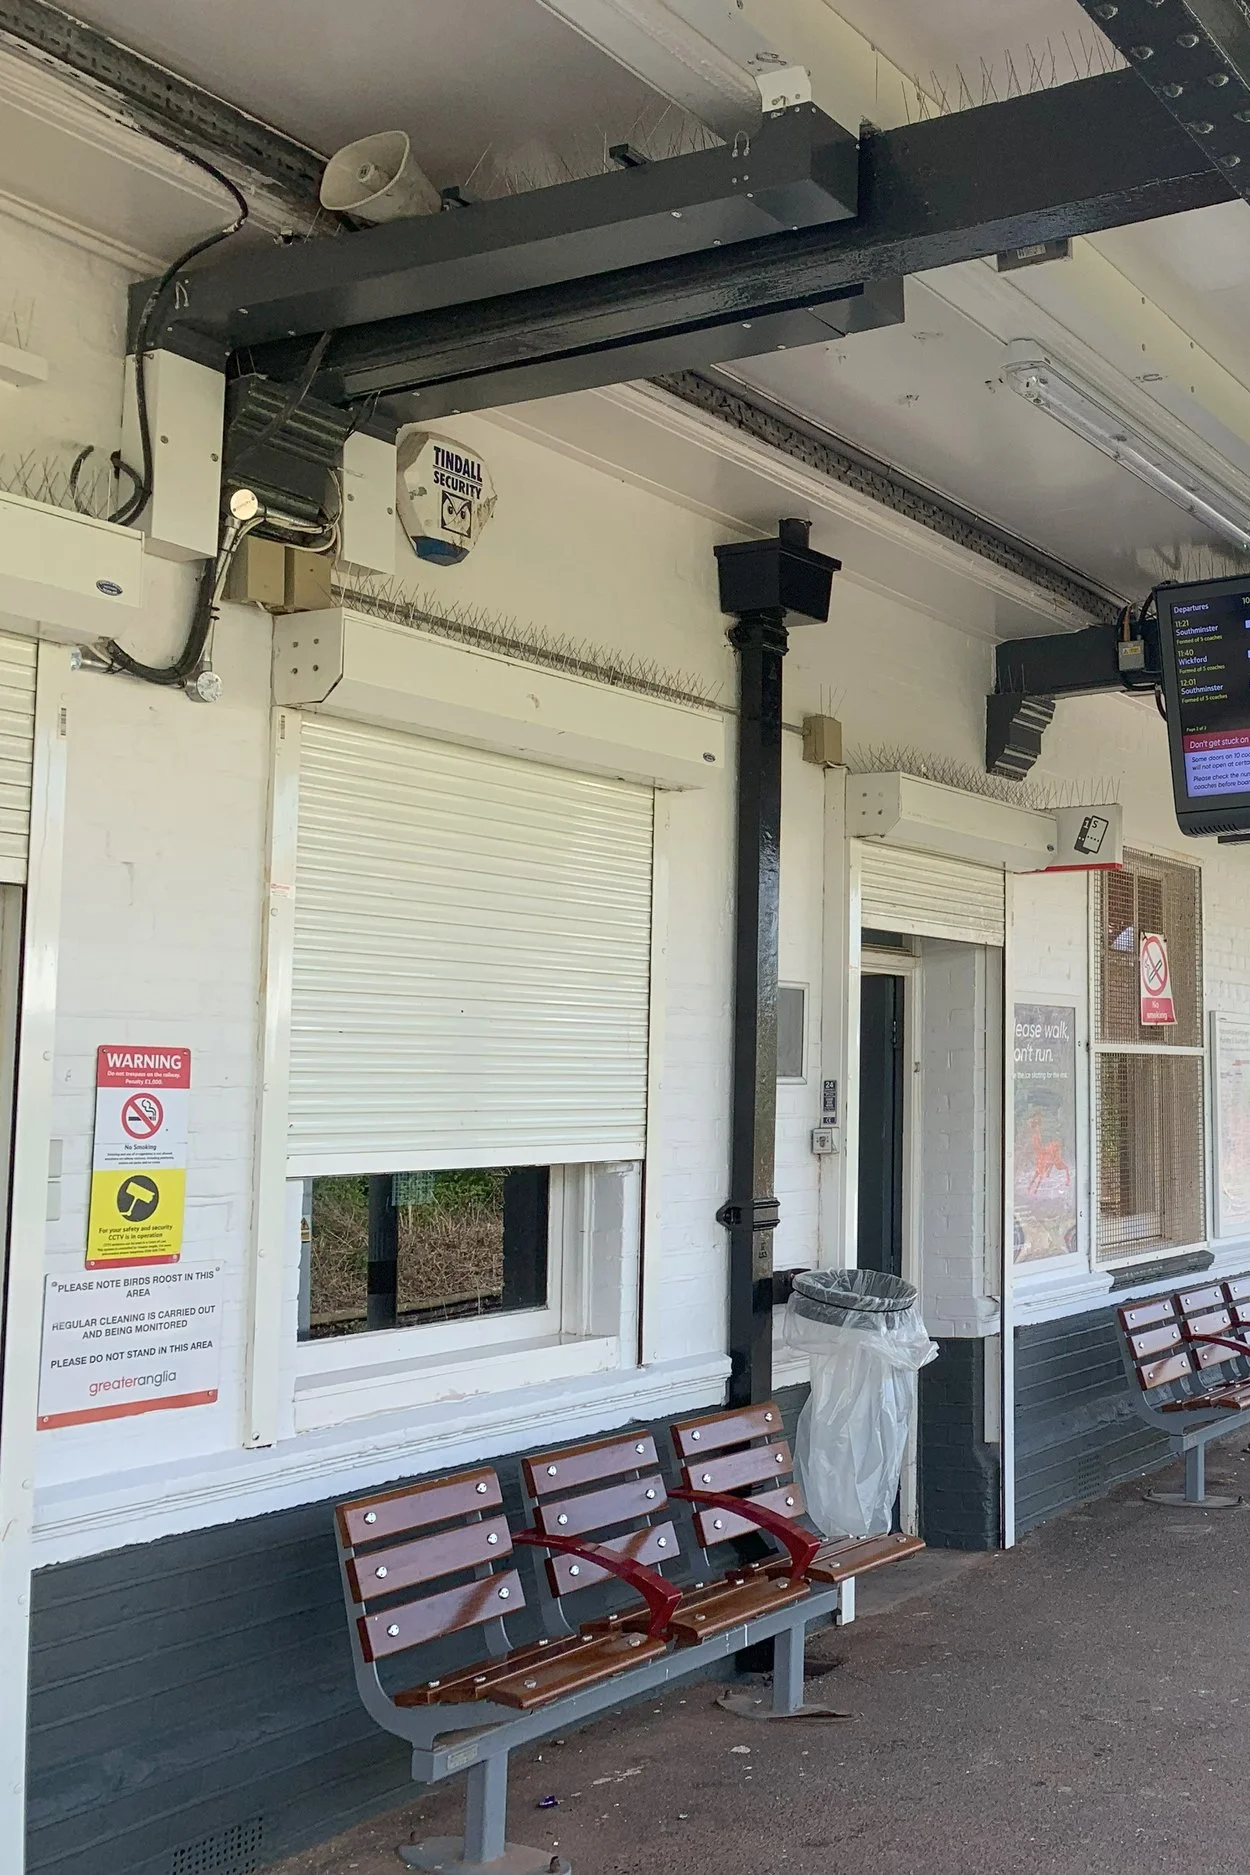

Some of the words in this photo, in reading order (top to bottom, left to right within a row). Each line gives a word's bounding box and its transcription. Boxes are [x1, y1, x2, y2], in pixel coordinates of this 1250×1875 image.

[433, 446, 483, 483] TINDALL
[433, 470, 481, 500] SECURITY
[1174, 604, 1209, 614] Departures
[1175, 620, 1189, 628] 11:21
[1176, 625, 1218, 636] Southminster
[1178, 649, 1194, 657] 11:40
[1178, 656, 1208, 666] Wickford
[1181, 684, 1224, 696] Southminster
[1190, 741, 1208, 749] Don't
[1208, 740, 1220, 748] get
[1222, 737, 1239, 746] stuck
[1147, 1011, 1167, 1020] smoking
[1014, 1019, 1041, 1038] lease
[1045, 1020, 1070, 1042] walk,
[107, 1053, 182, 1069] WARNING
[1014, 1044, 1033, 1062] on't
[1035, 1049, 1053, 1062] run.
[58, 1282, 94, 1293] PLEASE
[96, 1280, 121, 1290] NOTE
[123, 1277, 150, 1287] BIRDS
[153, 1274, 183, 1284] ROOST
[184, 1272, 193, 1281] IN
[195, 1271, 214, 1280] THIS
[126, 1289, 150, 1298] AREA
[52, 1319, 97, 1331] REGULAR
[99, 1313, 146, 1326] CLEANING
[147, 1311, 156, 1320] IS
[158, 1308, 196, 1319] CARRIED
[198, 1305, 216, 1315] OUT
[82, 1329, 103, 1339] AND
[105, 1325, 133, 1337] BEING
[135, 1320, 188, 1333] MONITORED
[50, 1357, 87, 1368] PLEASE
[89, 1355, 104, 1364] DO
[106, 1352, 125, 1362] NOT
[127, 1348, 156, 1359] STAND
[158, 1346, 168, 1354] IN
[170, 1344, 188, 1353] THIS
[190, 1341, 213, 1350] AREA
[88, 1370, 177, 1397] greateranglia
